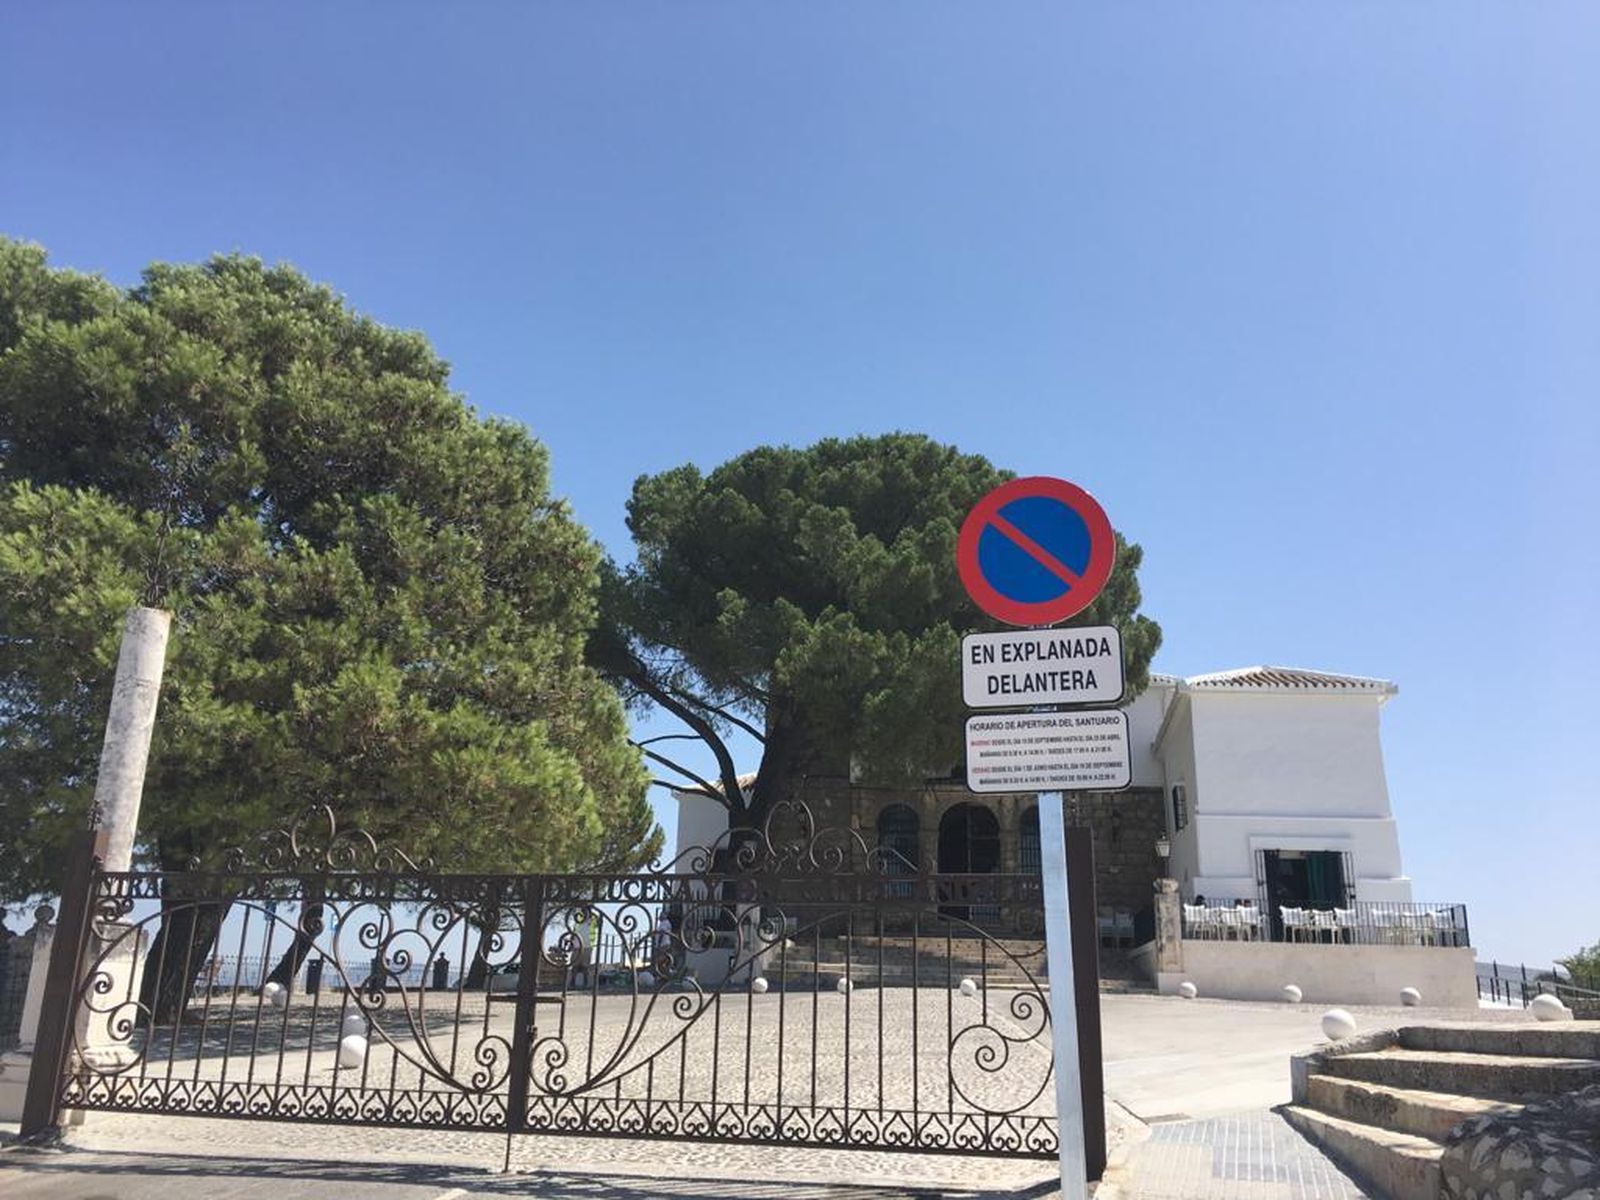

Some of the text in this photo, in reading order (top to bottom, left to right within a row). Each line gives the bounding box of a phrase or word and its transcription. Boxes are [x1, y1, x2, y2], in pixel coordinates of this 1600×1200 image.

[971, 637, 1112, 665] EN EXPLANADA
[987, 669, 1098, 696] DELANTERA
[969, 714, 1120, 733] HORARIO DE APERTURA DEL SANTUARIO
[593, 878, 690, 901] LUCENA
